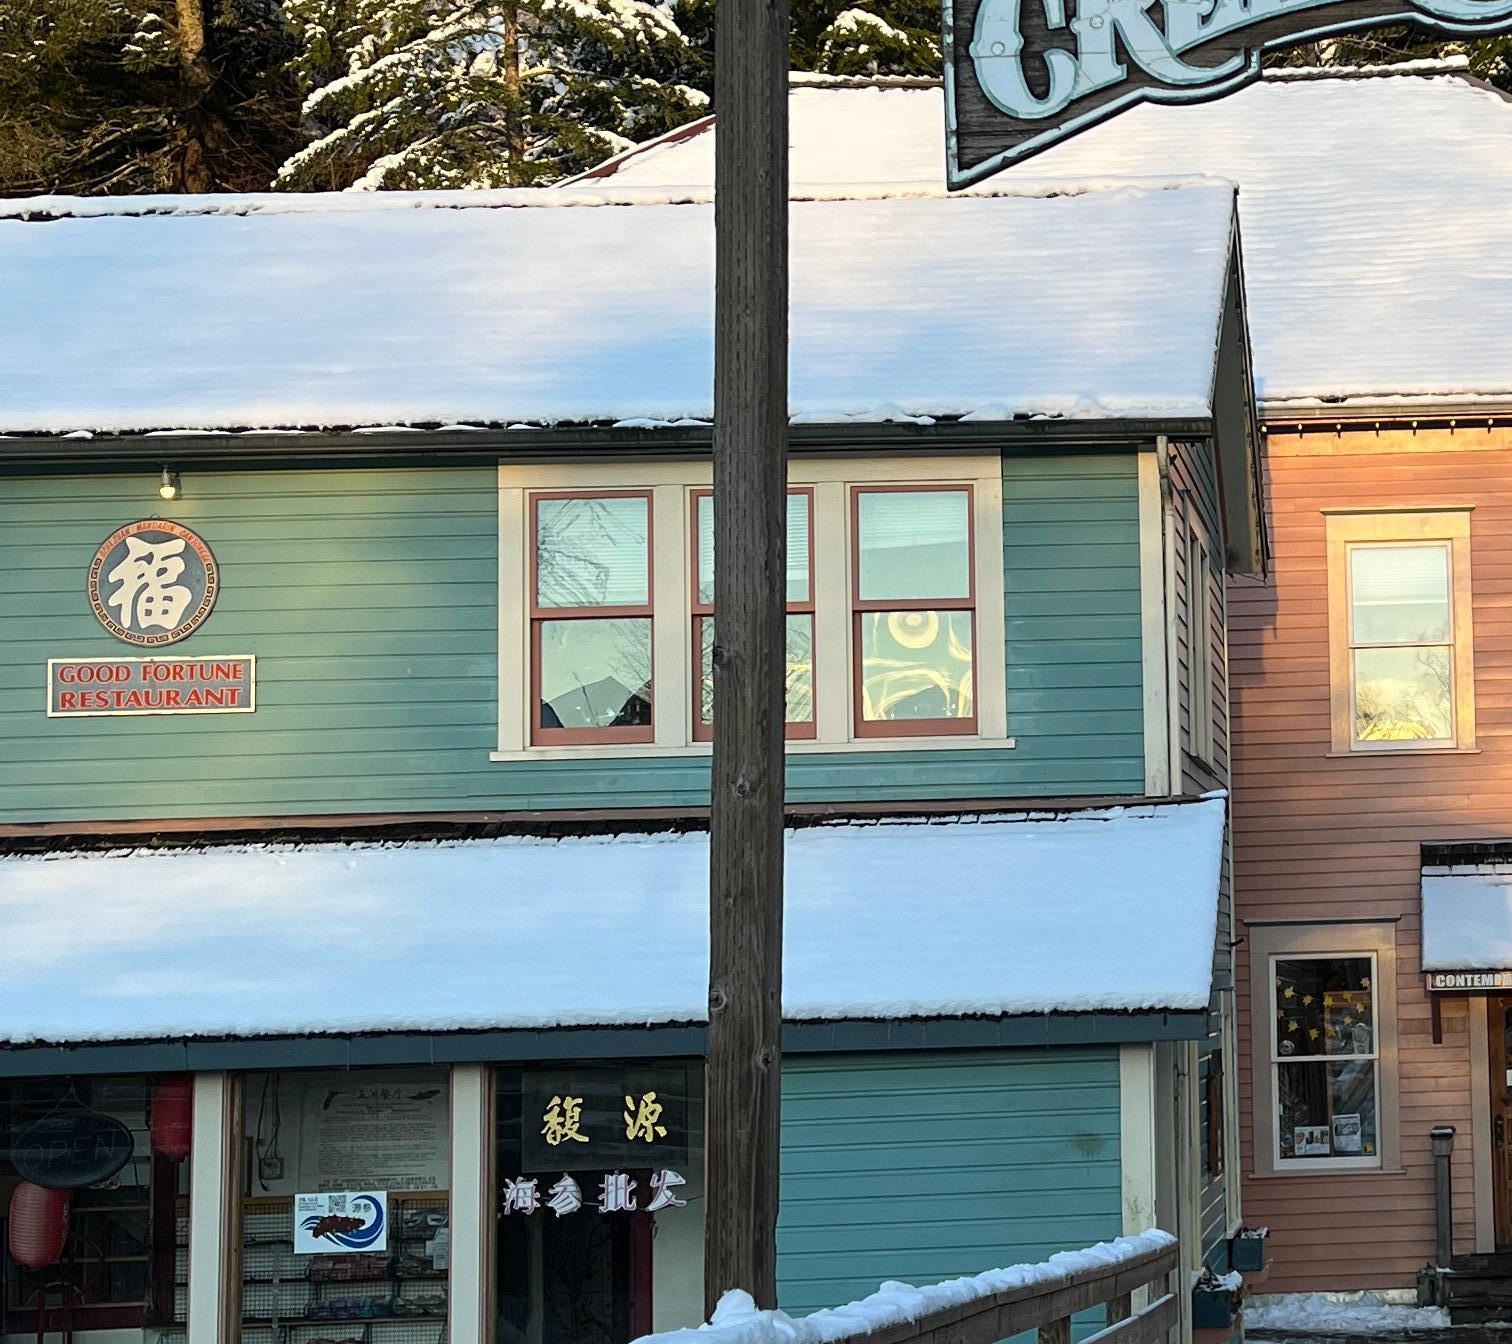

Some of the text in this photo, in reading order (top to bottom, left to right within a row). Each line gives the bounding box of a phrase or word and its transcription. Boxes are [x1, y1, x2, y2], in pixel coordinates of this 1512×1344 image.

[107, 536, 193, 631] 福
[58, 662, 244, 684] GOOD FORTUNE
[59, 687, 242, 710] RESTAURANT
[23, 1131, 117, 1170] OPEN
[503, 1169, 688, 1217] 海参批发
